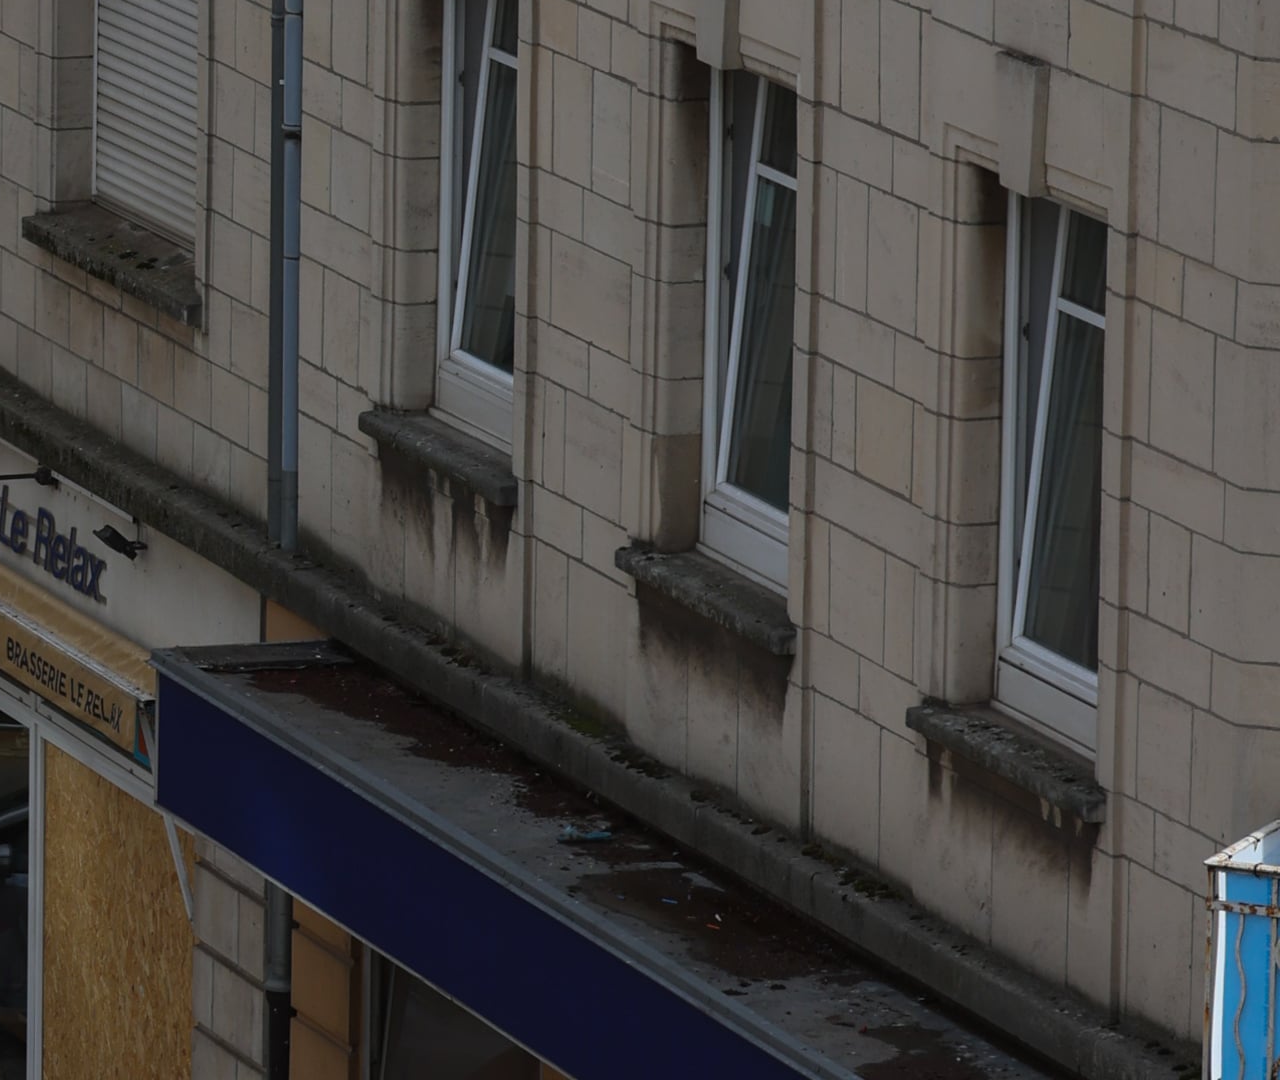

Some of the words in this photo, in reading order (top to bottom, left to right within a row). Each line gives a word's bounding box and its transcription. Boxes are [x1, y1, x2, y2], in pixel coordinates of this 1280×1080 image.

[34, 507, 107, 603] Relax
[7, 637, 67, 697] BRASSERIE
[70, 678, 85, 708] LE
